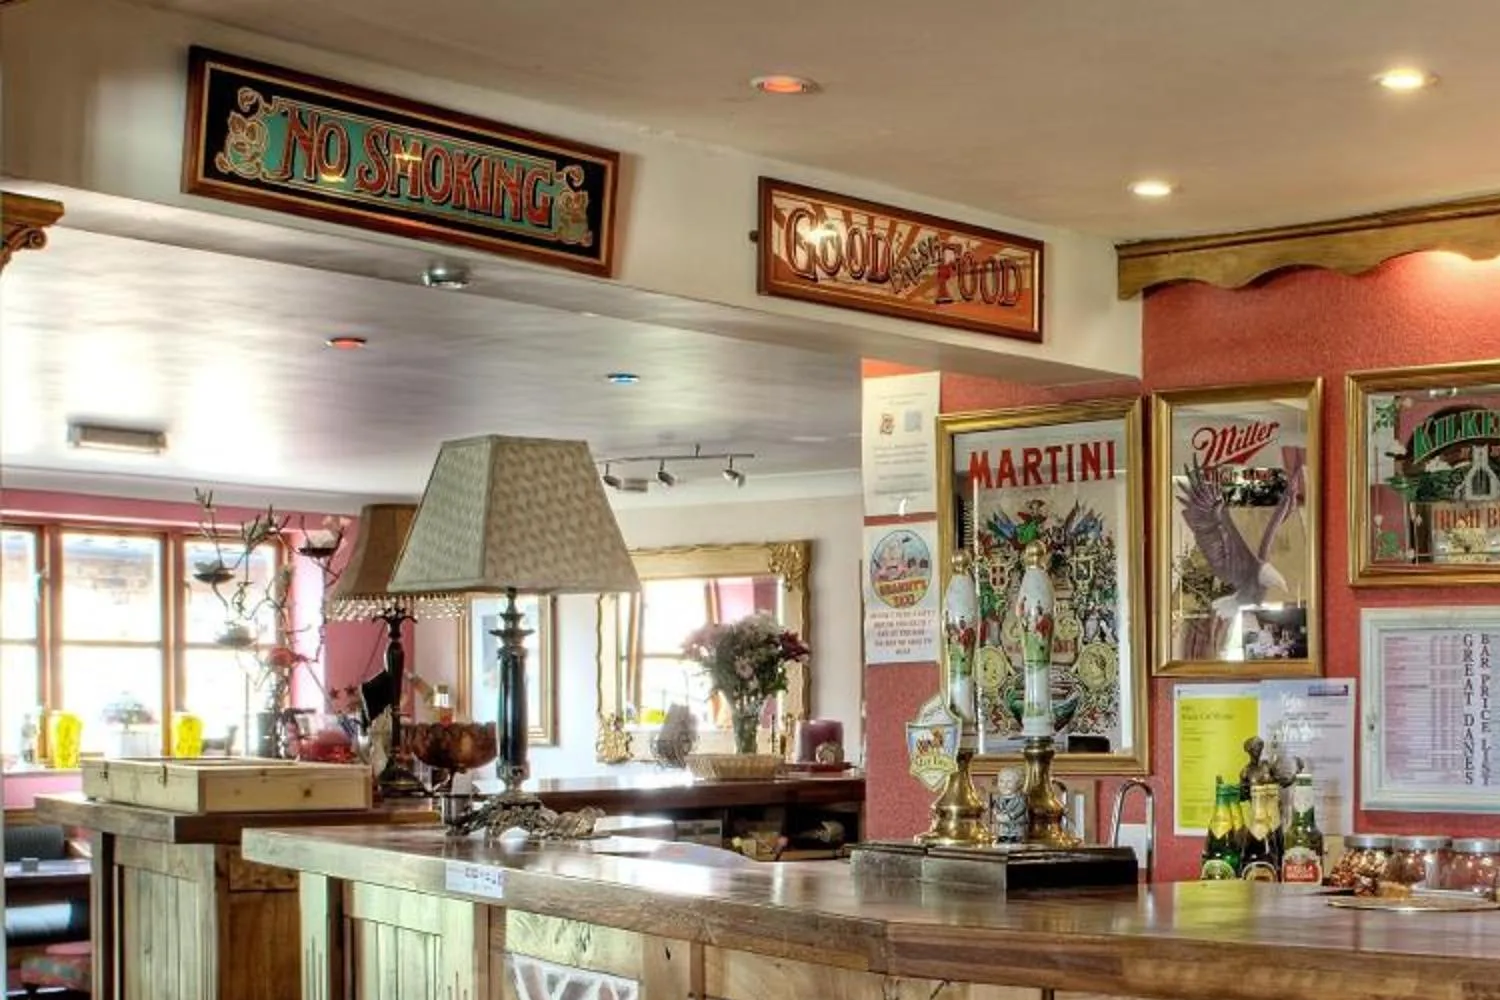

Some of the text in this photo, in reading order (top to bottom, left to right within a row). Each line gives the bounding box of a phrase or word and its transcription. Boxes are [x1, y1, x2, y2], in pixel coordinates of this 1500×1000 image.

[278, 103, 554, 230] NO SMOKING
[785, 208, 892, 284] GOOD
[935, 242, 1023, 307] FOOD
[969, 440, 1117, 489] MARTINI
[1192, 421, 1280, 469] Miller
[1480, 633, 1491, 669] BAR
[1463, 633, 1475, 786] GREAT DANES
[1480, 674, 1491, 734] PRICE
